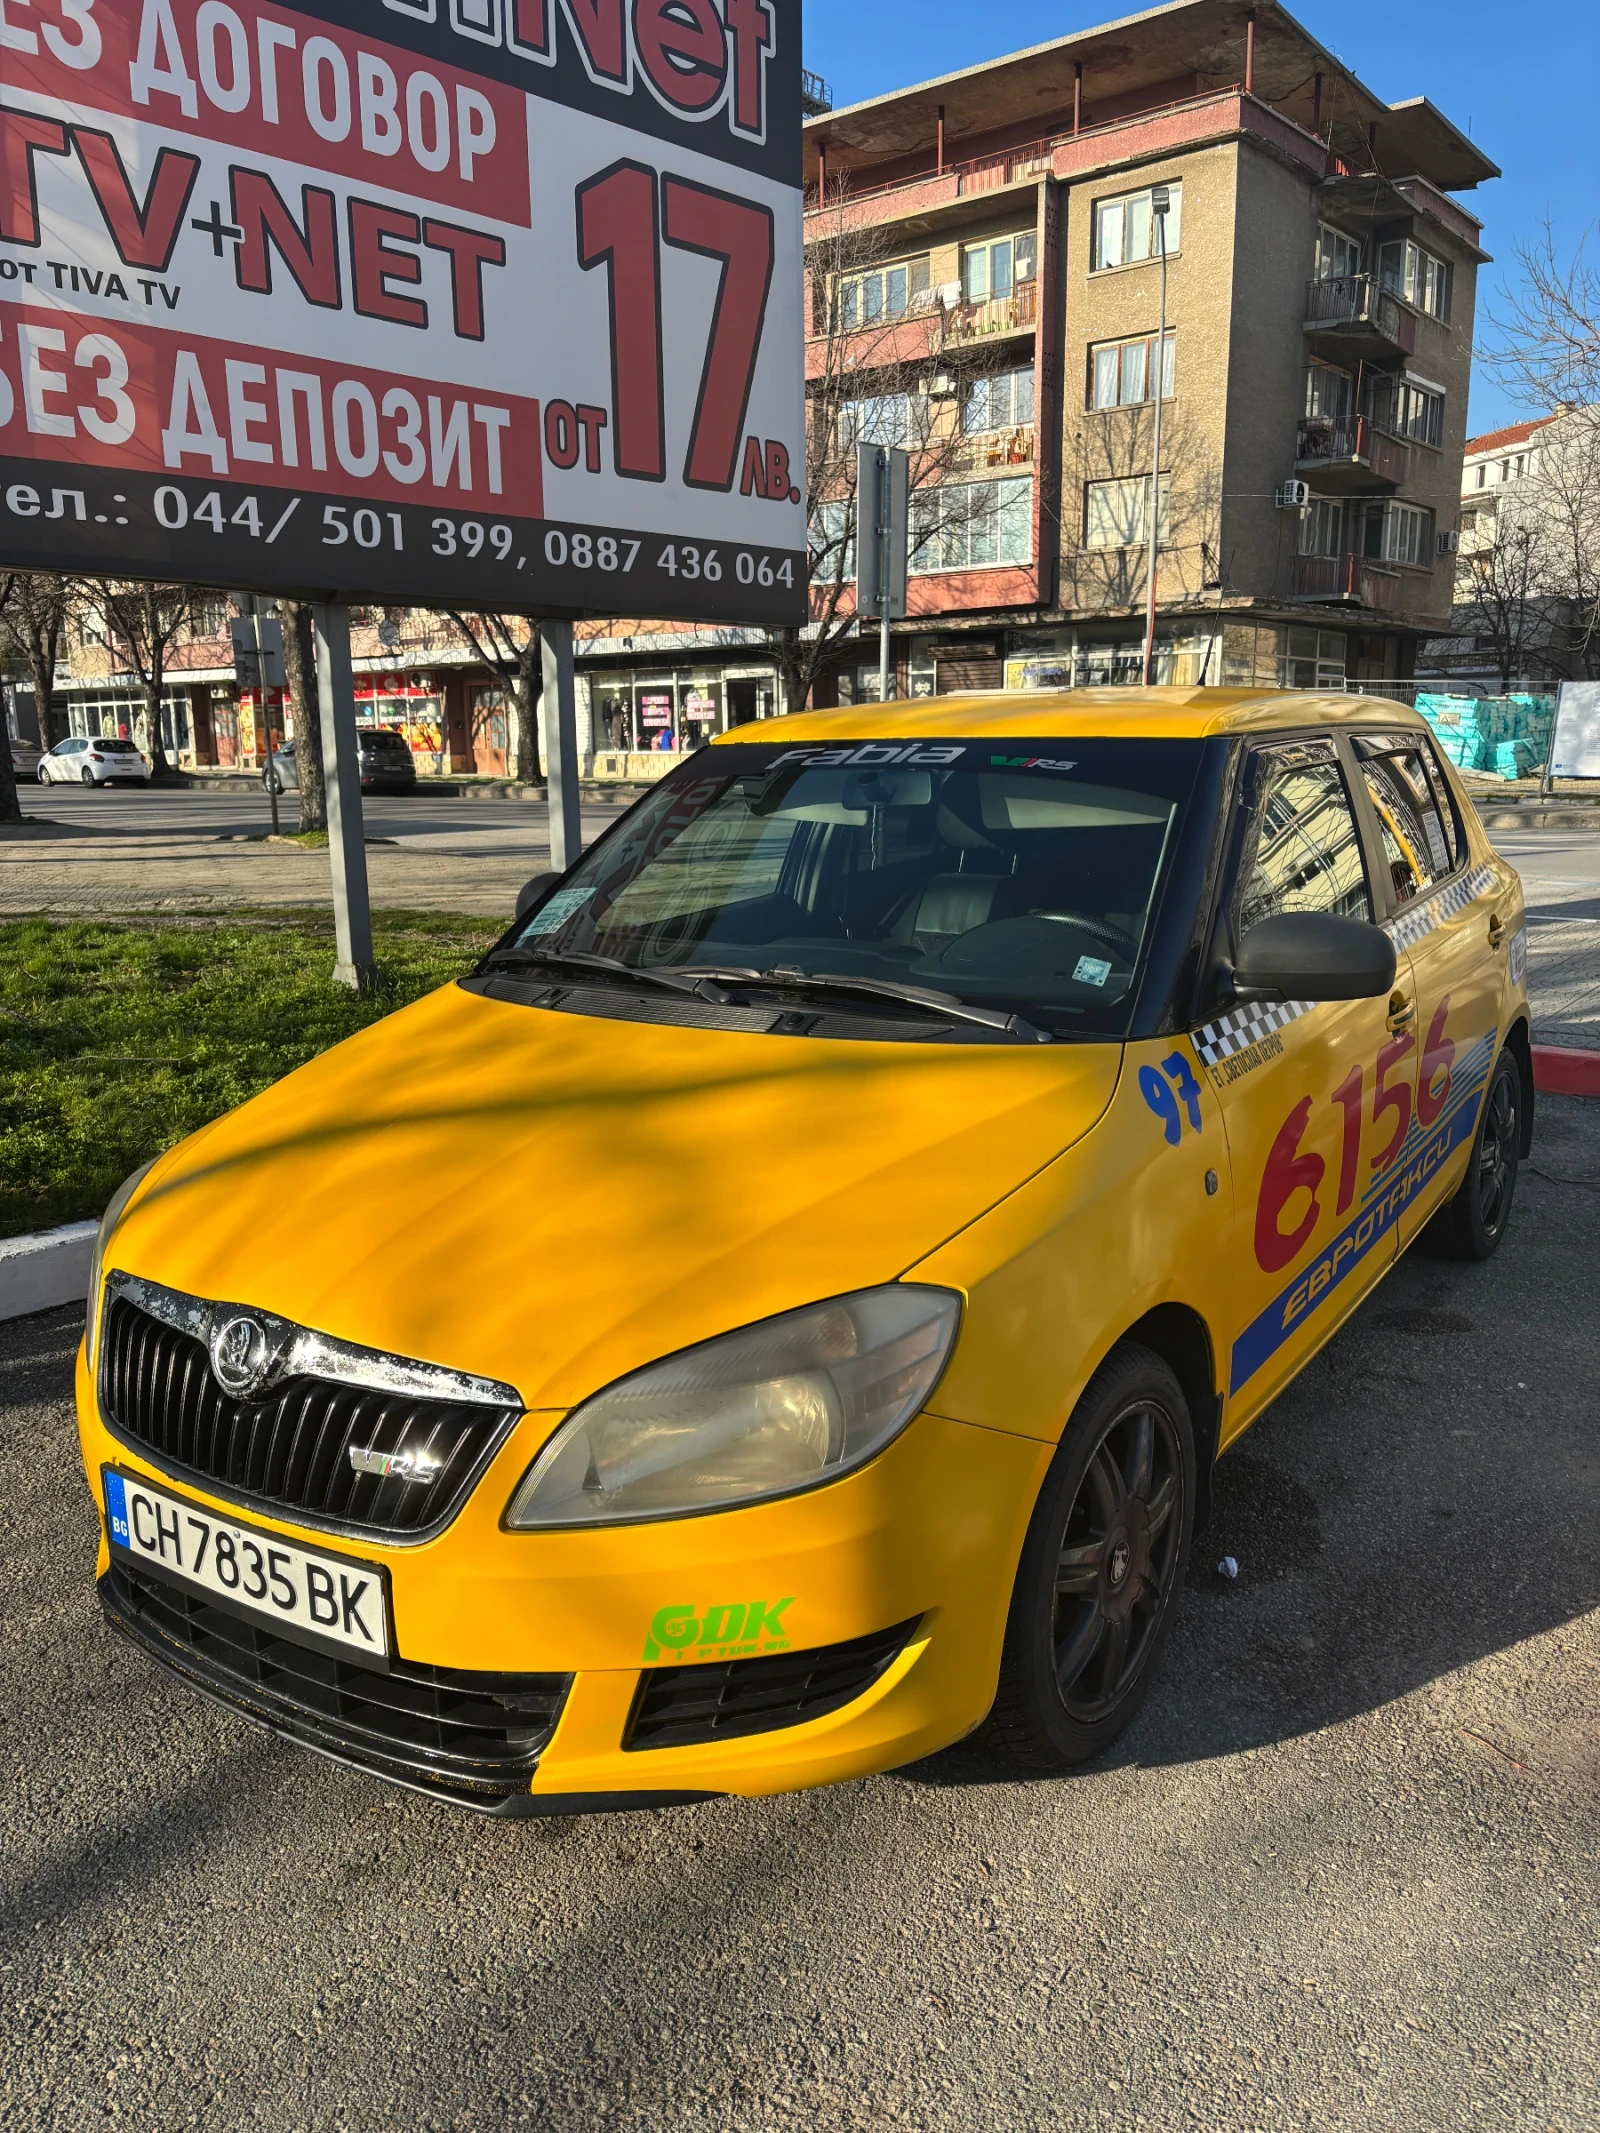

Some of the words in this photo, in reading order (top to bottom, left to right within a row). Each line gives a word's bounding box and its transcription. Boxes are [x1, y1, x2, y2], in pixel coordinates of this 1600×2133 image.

[129, 0, 497, 182] ДОГОВОР
[0, 258, 38, 284] от
[46, 260, 130, 301] TIVA
[136, 278, 182, 310] TV
[574, 156, 774, 494] 17
[161, 349, 511, 495] ДЕПОЗИТ
[543, 398, 607, 474] ОТ
[739, 435, 801, 505] ЛВ.
[0, 484, 130, 525] ел.:
[153, 485, 301, 543] 044/
[321, 505, 404, 551] 501
[431, 518, 527, 570] 399,
[544, 530, 642, 573] 0887
[657, 544, 723, 582] 436
[735, 552, 795, 589] 064
[765, 743, 967, 770] Fabia
[1138, 1049, 1203, 1148] 97
[1254, 993, 1456, 1274] 6156
[1281, 1126, 1452, 1331] ЕВРОТАКСИ
[112, 1515, 128, 1537] BG
